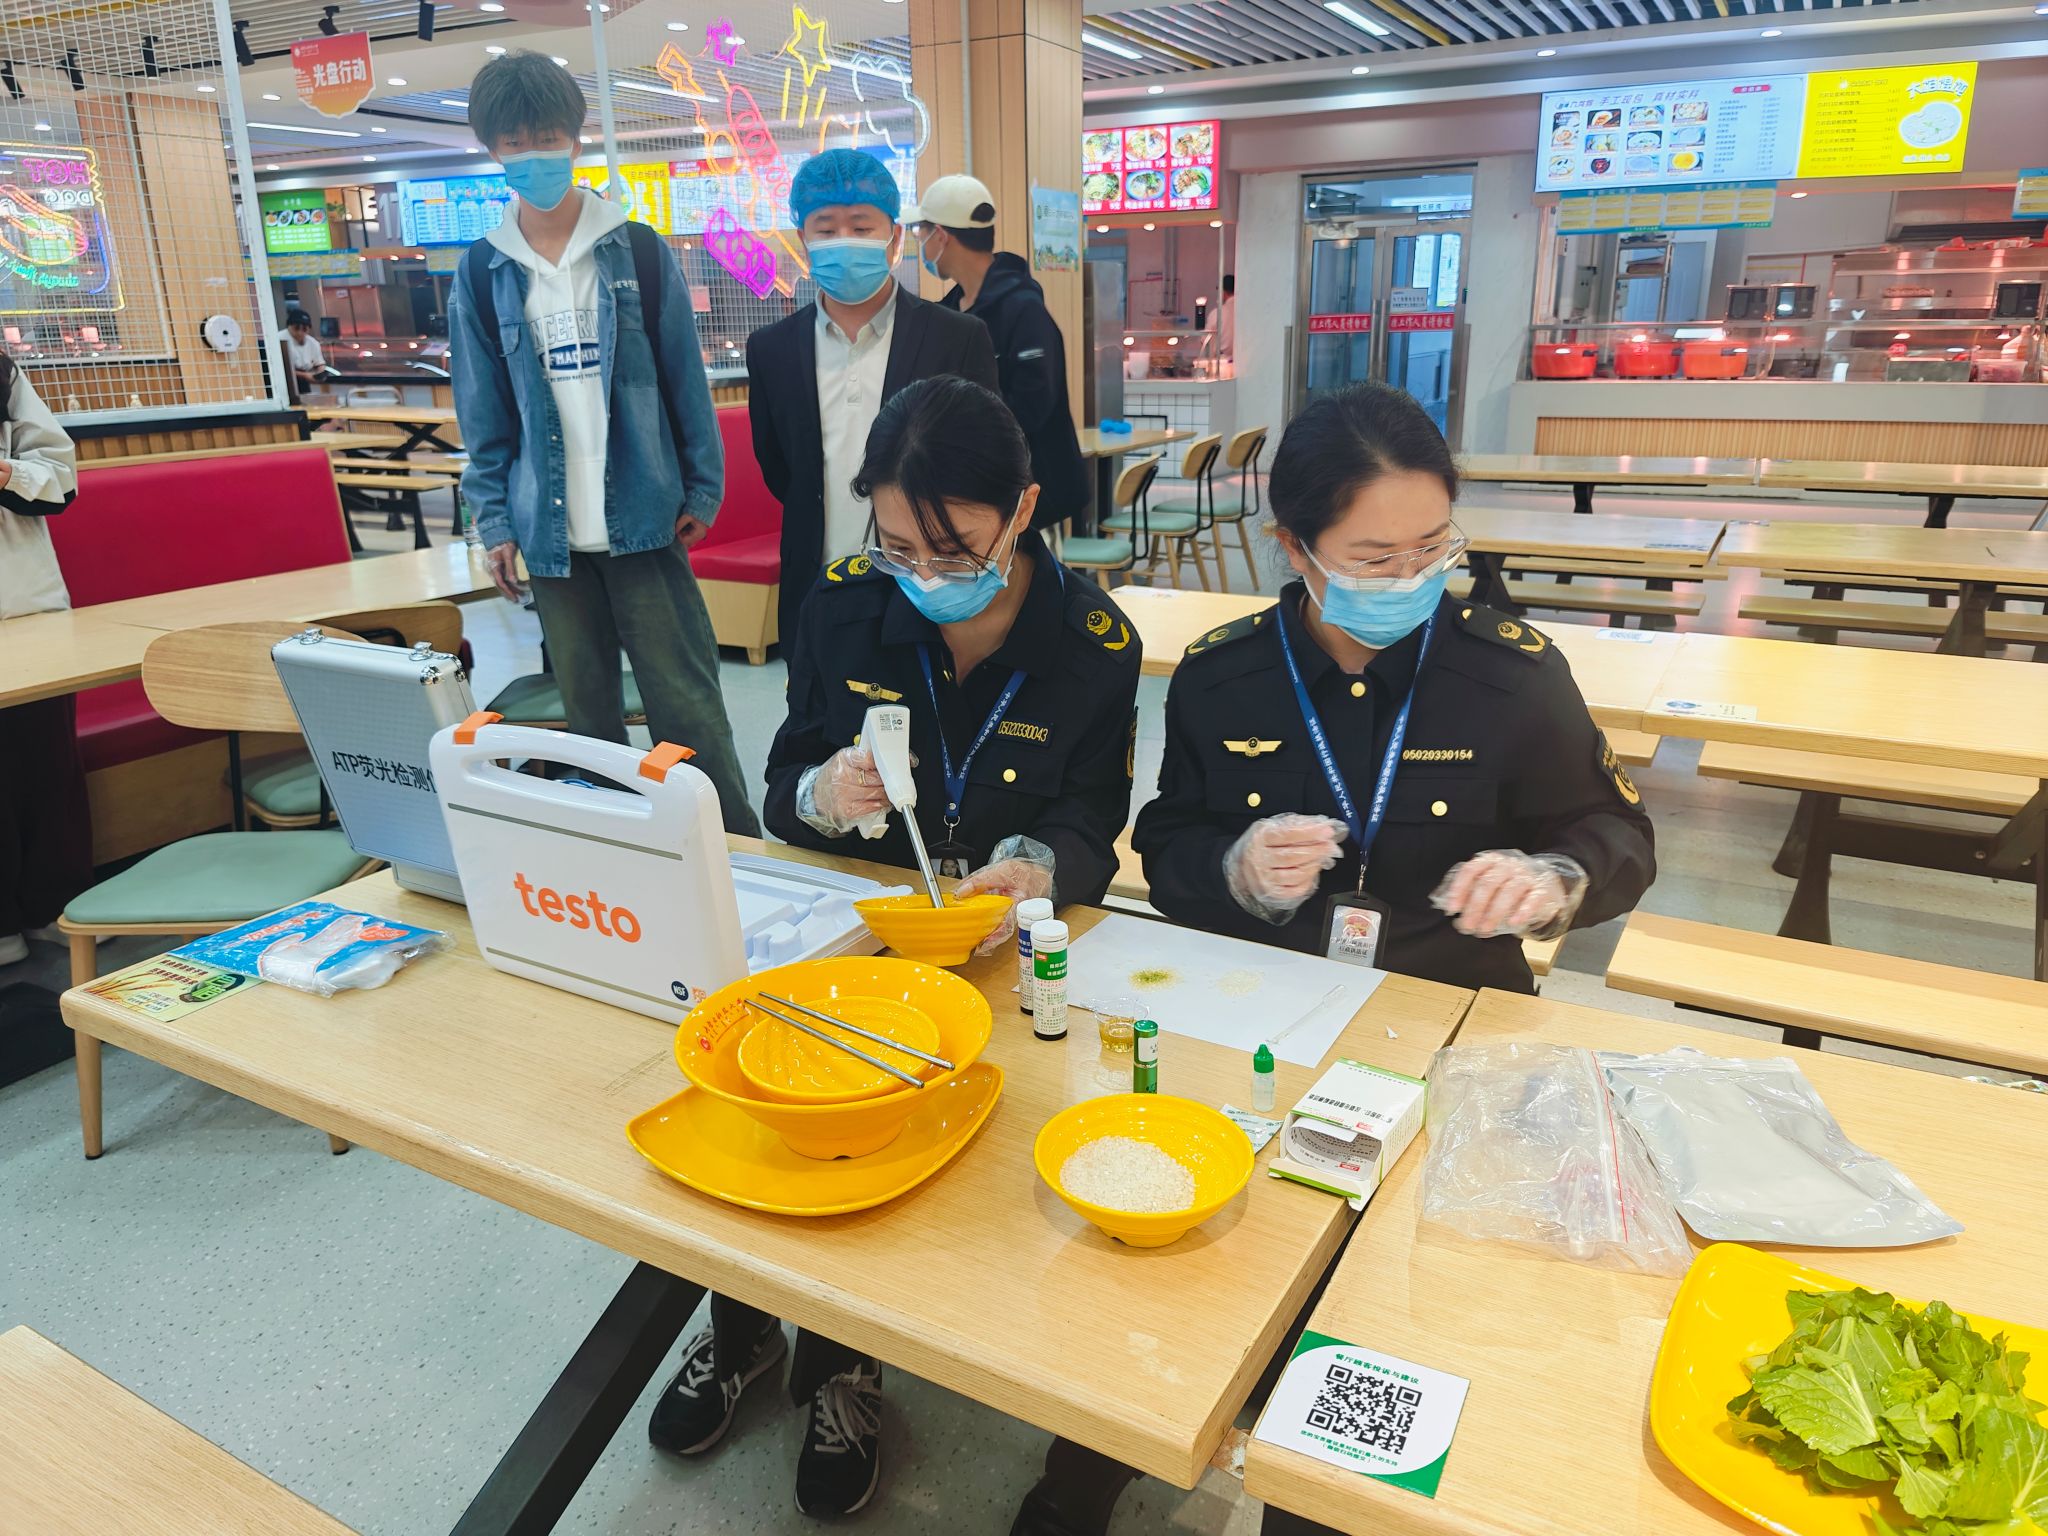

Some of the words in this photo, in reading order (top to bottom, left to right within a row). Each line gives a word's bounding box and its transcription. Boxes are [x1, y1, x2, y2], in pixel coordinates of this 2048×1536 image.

[312, 57, 367, 88] 光盘行动
[1402, 748, 1473, 761] 05020330154
[513, 872, 641, 943] testo
[673, 984, 686, 997] NSF
[1334, 1352, 1420, 1385] 餐厅顾客投诉与建议
[1299, 1429, 1399, 1468] 您的宝贵建议是对我们最大的支持
